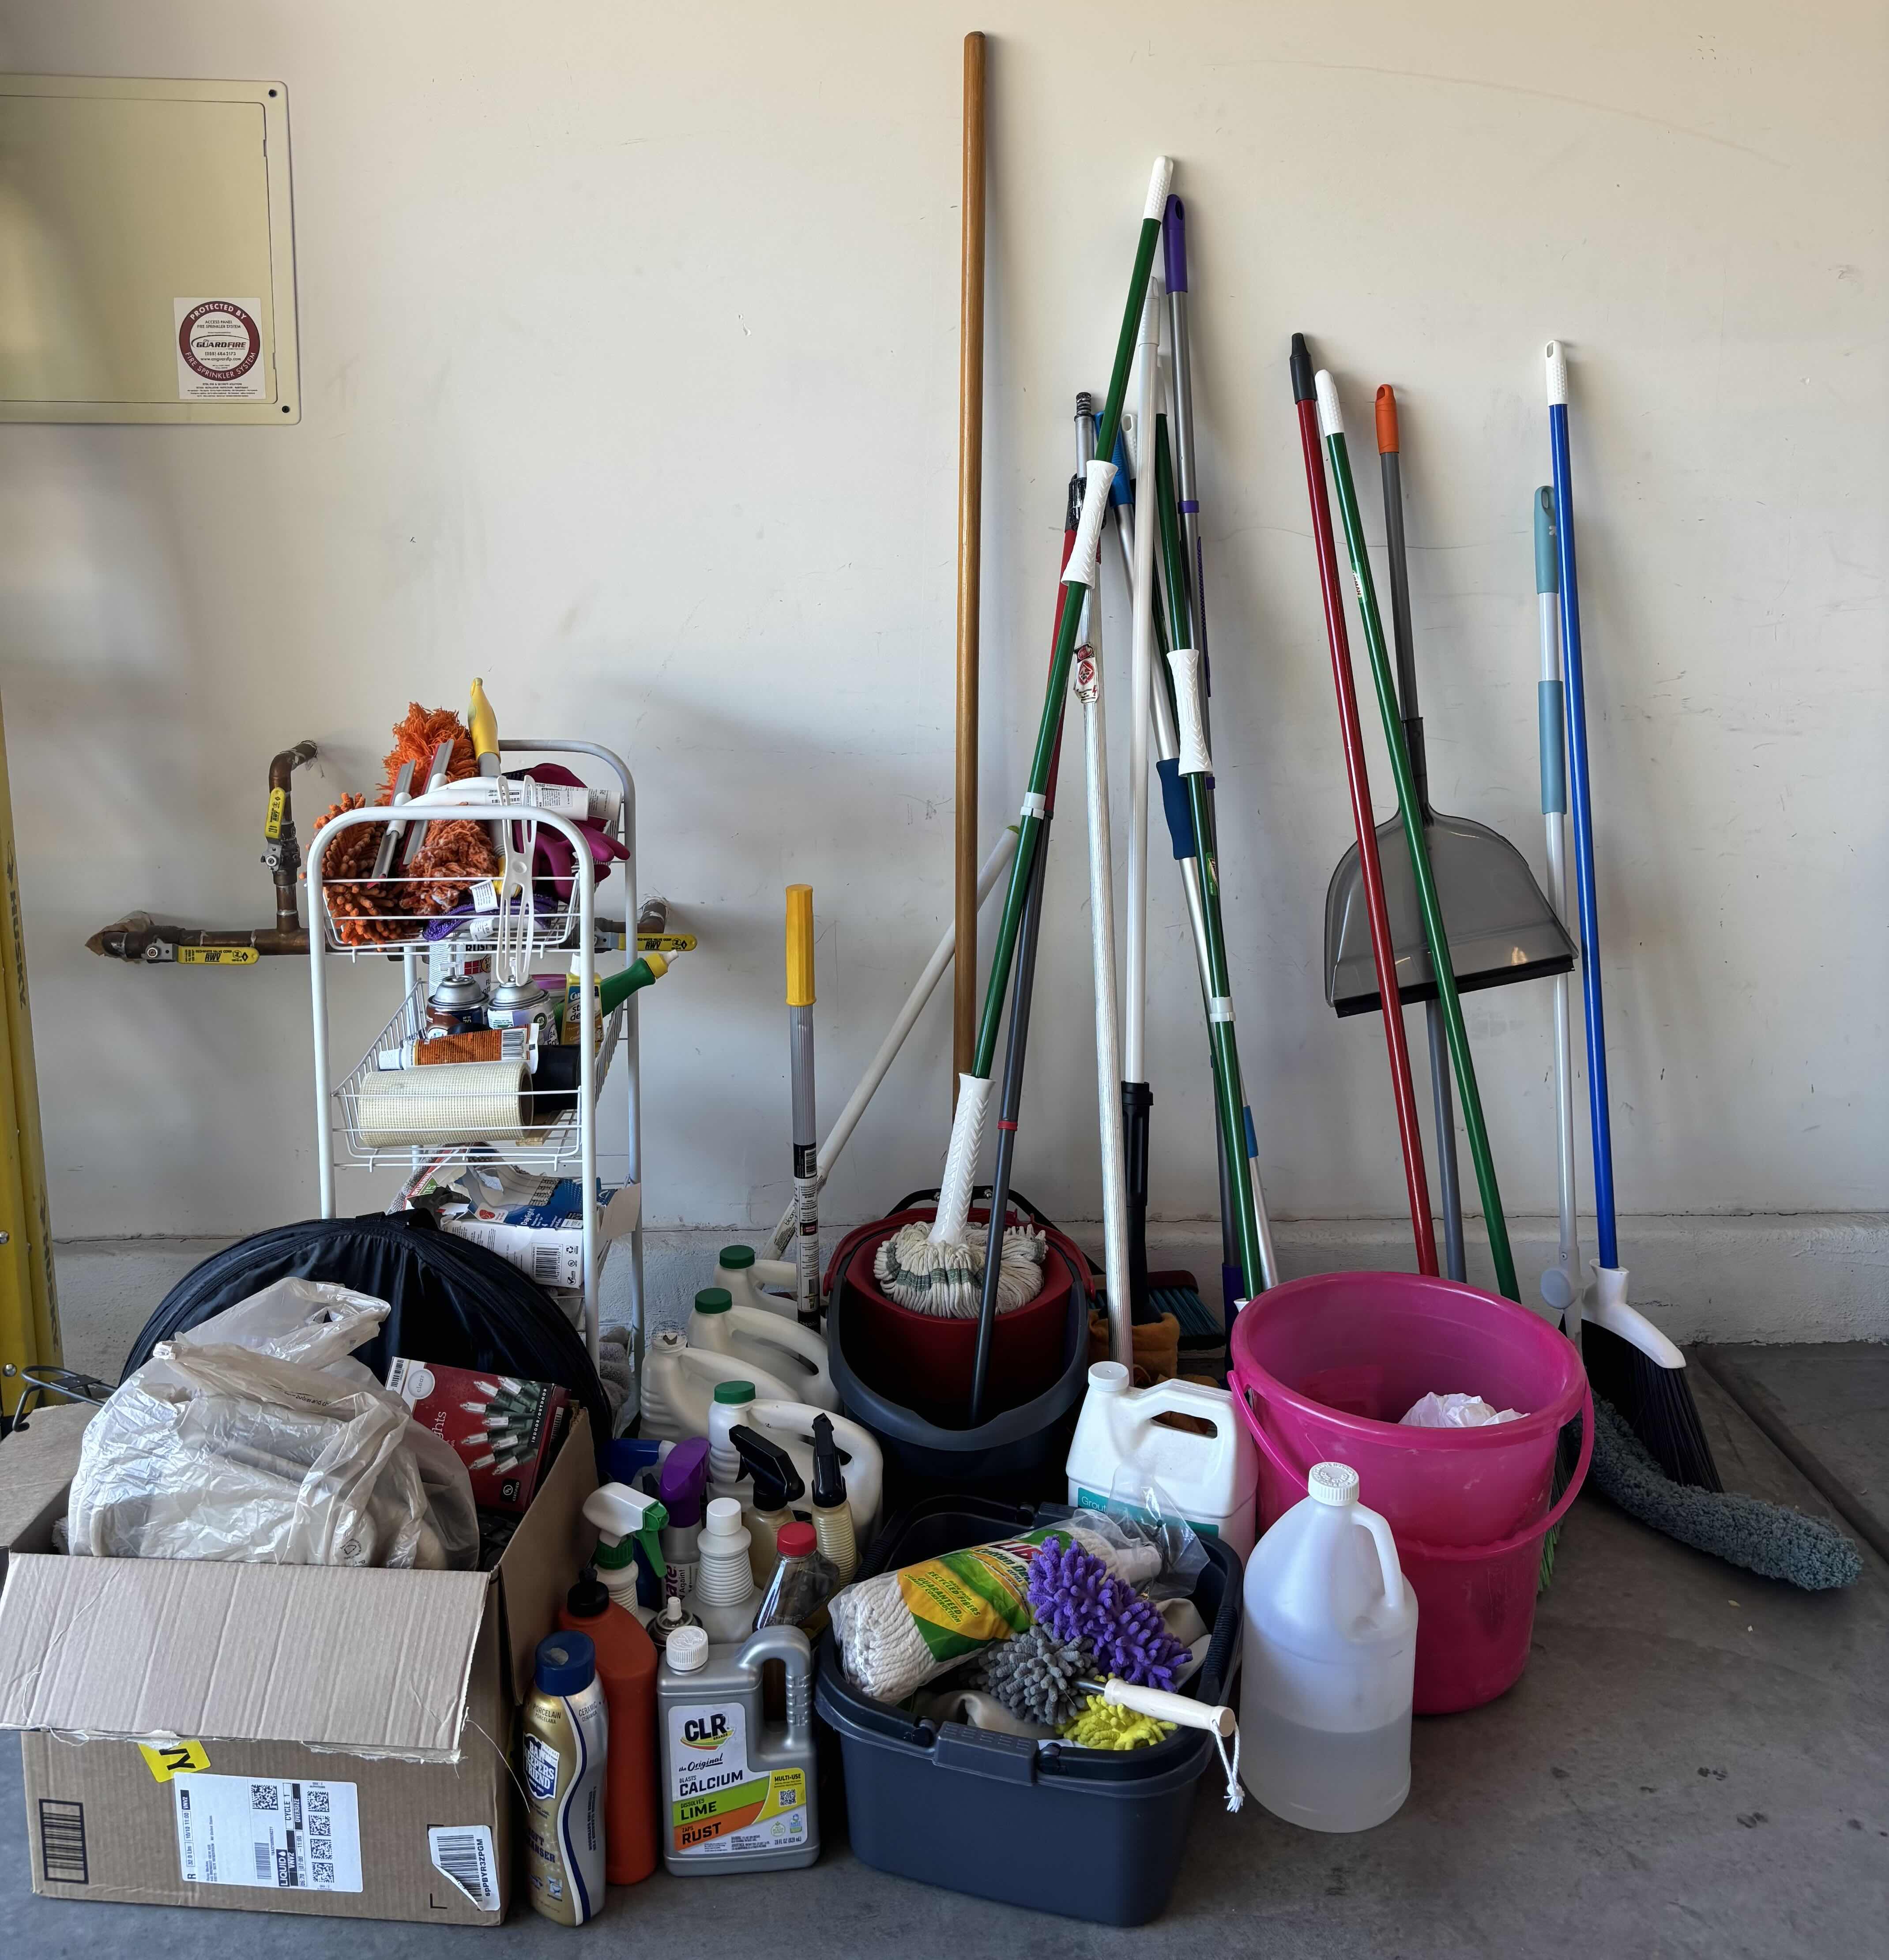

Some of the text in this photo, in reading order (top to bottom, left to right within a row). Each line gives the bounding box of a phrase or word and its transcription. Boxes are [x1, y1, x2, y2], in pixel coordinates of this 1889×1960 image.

[190, 304, 247, 320] PROTECTED BY
[185, 352, 256, 379] FIRE SPRINKLER SYSTEM
[10, 890, 26, 1010] HUSKY
[205, 953, 221, 961] RWV
[520, 1208, 535, 1225] Daylight
[44, 1232, 59, 1352] HUSKY
[433, 1411, 447, 1442] ghts
[531, 1388, 547, 1442] INDOOR/OUTDOOR
[1082, 1496, 1106, 1512] Grout
[974, 1549, 1016, 1565] Cotton
[988, 1541, 1043, 1564] LIB
[1007, 1569, 1023, 1583] REFILL
[918, 1578, 962, 1614] GUARANTEED
[928, 1571, 959, 1595] RECYCLED
[958, 1596, 981, 1616] FIBERS
[925, 1589, 961, 1623] CONSTRUCTION
[533, 1704, 561, 1719] PORCELAIN
[536, 1713, 556, 1724] PORCELANA
[579, 1702, 597, 1716] CERAMIC
[685, 1713, 727, 1742] CLR
[525, 1748, 554, 1779] KEEPERS
[688, 1753, 723, 1771] Original
[526, 1760, 550, 1789] FRIEND
[680, 1775, 696, 1783] BLASTS
[680, 1770, 743, 1796] CALCIUM
[775, 1773, 801, 1782] MULTI-USE
[681, 1798, 704, 1809] DISSOLVES
[681, 1801, 717, 1821] LIME
[682, 1822, 722, 1845] RUST
[278, 1858, 289, 1886] LIQUID
